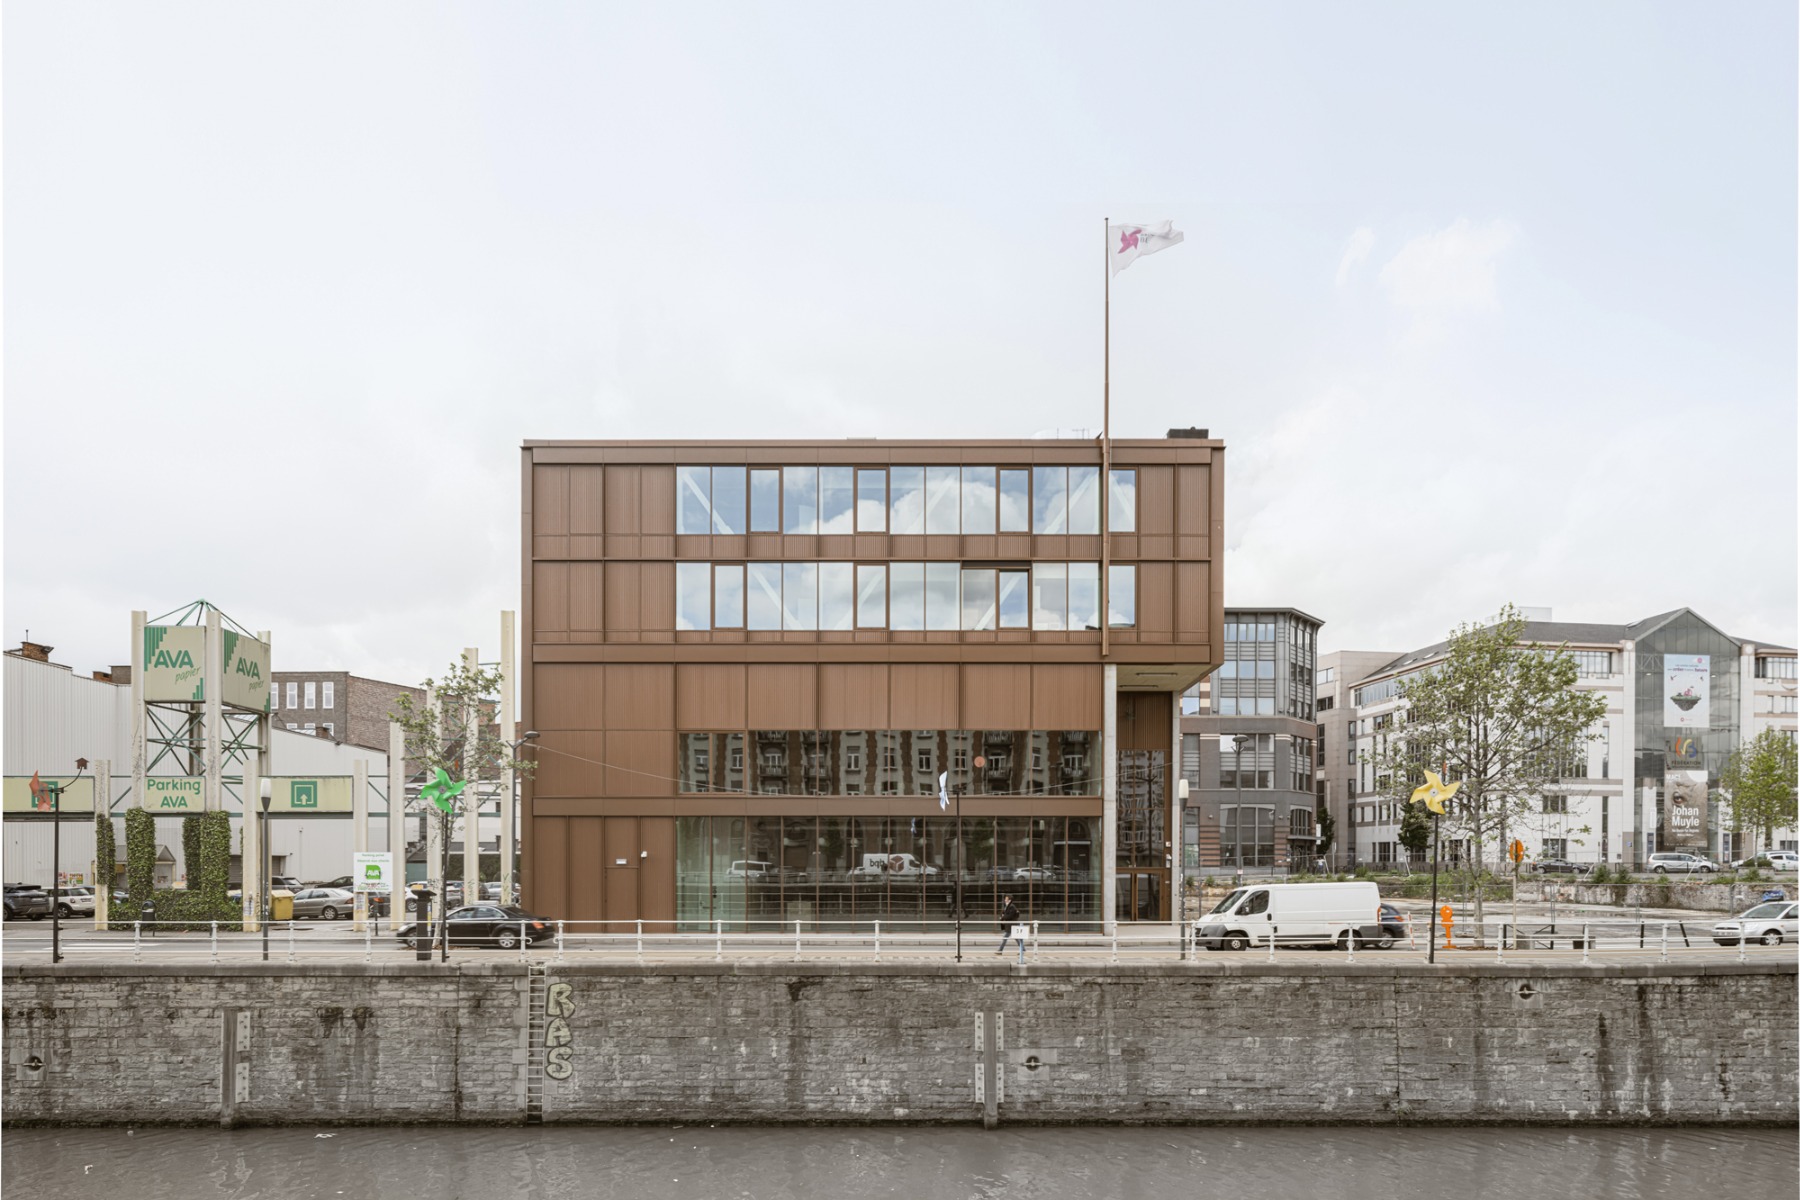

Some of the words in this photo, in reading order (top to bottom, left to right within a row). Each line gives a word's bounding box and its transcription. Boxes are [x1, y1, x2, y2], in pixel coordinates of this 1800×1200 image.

[154, 650, 194, 668] AVA
[175, 666, 201, 685] papier
[236, 657, 261, 680] AVA
[248, 680, 264, 693] papier
[147, 779, 201, 795] Parking
[160, 796, 188, 808] AVA
[1672, 804, 1699, 816] Johan
[1671, 816, 1700, 828] Muyle
[545, 982, 577, 1081] RAS
